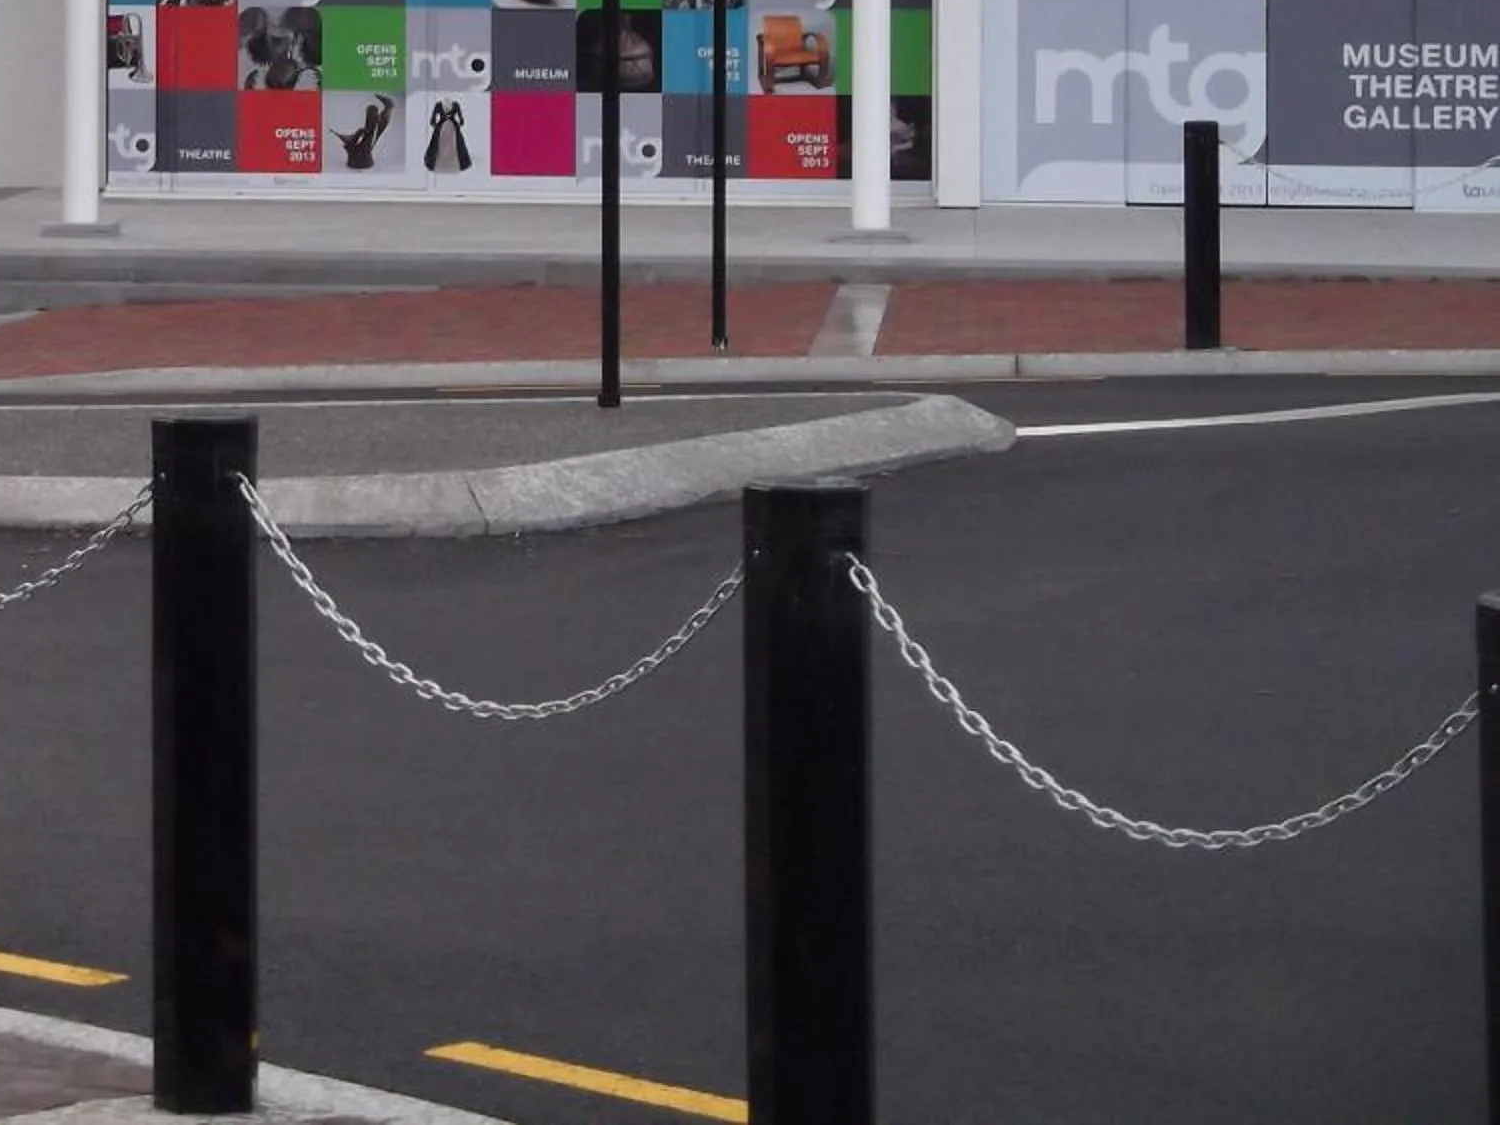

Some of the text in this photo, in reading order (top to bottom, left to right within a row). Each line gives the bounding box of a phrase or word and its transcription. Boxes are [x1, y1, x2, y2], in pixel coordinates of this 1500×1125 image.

[357, 45, 397, 55] OPENS
[1343, 44, 1498, 68] MUSEUM
[367, 57, 396, 66] SEPT
[515, 69, 569, 80] MUSEUM
[1349, 75, 1498, 98] THEATRE
[1035, 24, 1266, 165] mtg
[1343, 105, 1499, 130] GALLERY
[275, 129, 315, 138] OPENS
[787, 134, 829, 144] OPENS
[285, 141, 315, 150] SEPT
[798, 145, 829, 155] SEPT
[179, 149, 231, 160] THEATRE
[802, 157, 829, 167] 2013
